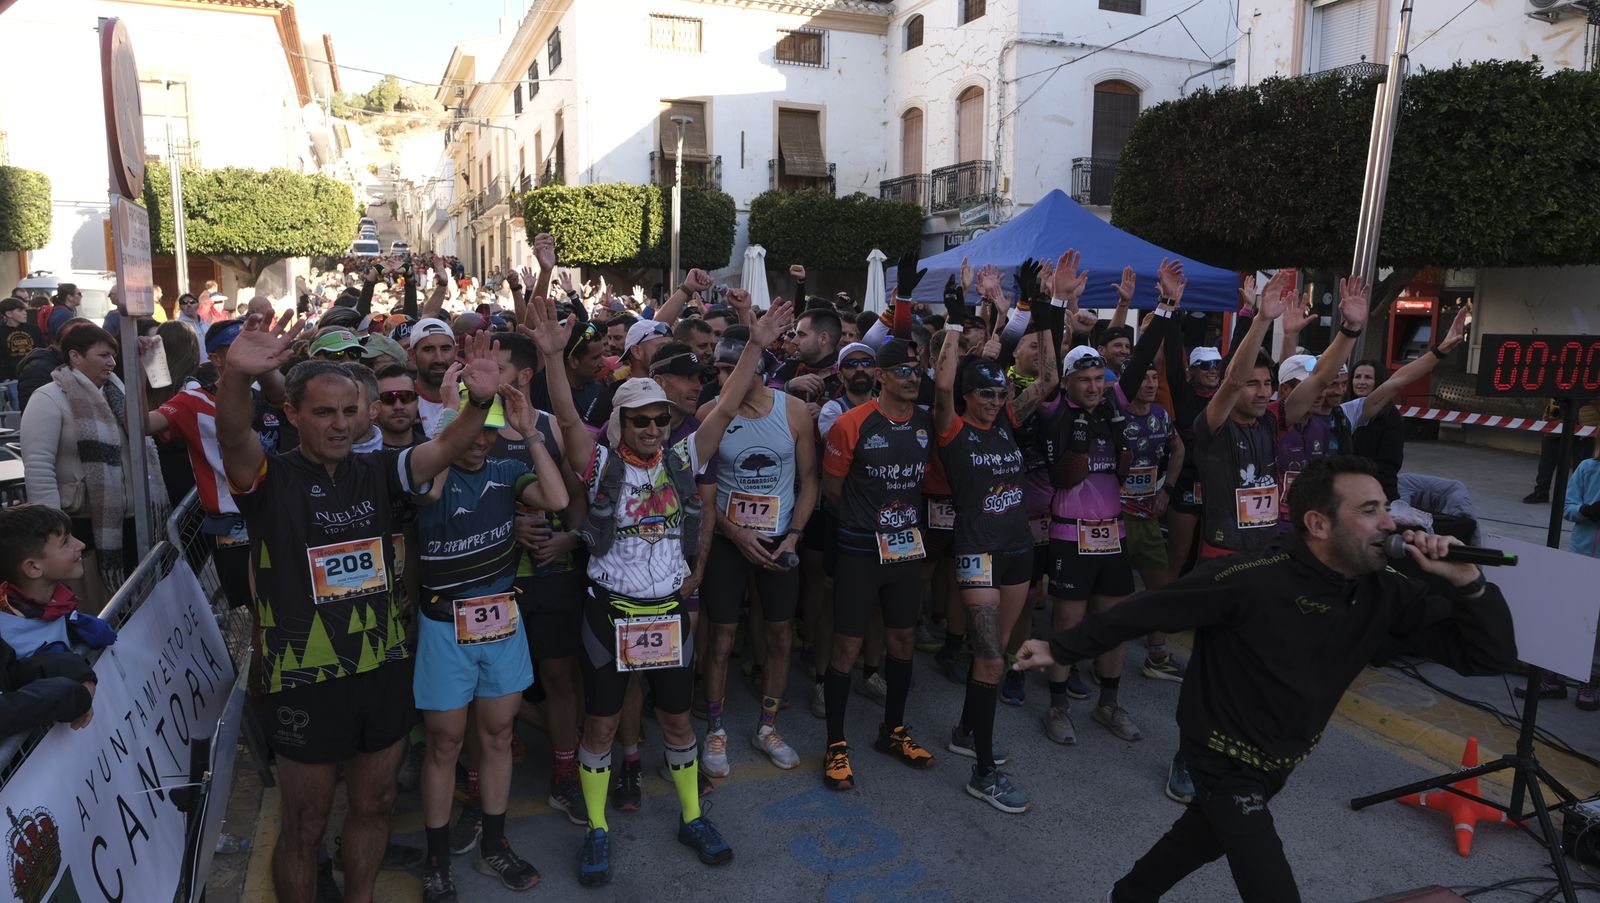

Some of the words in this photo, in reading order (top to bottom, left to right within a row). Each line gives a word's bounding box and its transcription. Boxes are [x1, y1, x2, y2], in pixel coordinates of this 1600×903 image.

[865, 463, 900, 480] TORRE
[1126, 474, 1151, 485] 368
[737, 501, 770, 515] 117
[1252, 495, 1272, 509] 77
[887, 531, 915, 546] 256
[1090, 527, 1110, 539] 93
[427, 540, 442, 553] CD
[443, 530, 489, 553] SIEMPRE
[325, 552, 373, 577] 208
[956, 556, 981, 569] 201
[474, 605, 500, 623] 31
[636, 632, 663, 648] 43
[76, 626, 183, 832] AYUNTAMIENTO
[183, 604, 199, 634] DE
[91, 636, 223, 903] CANTORIA
